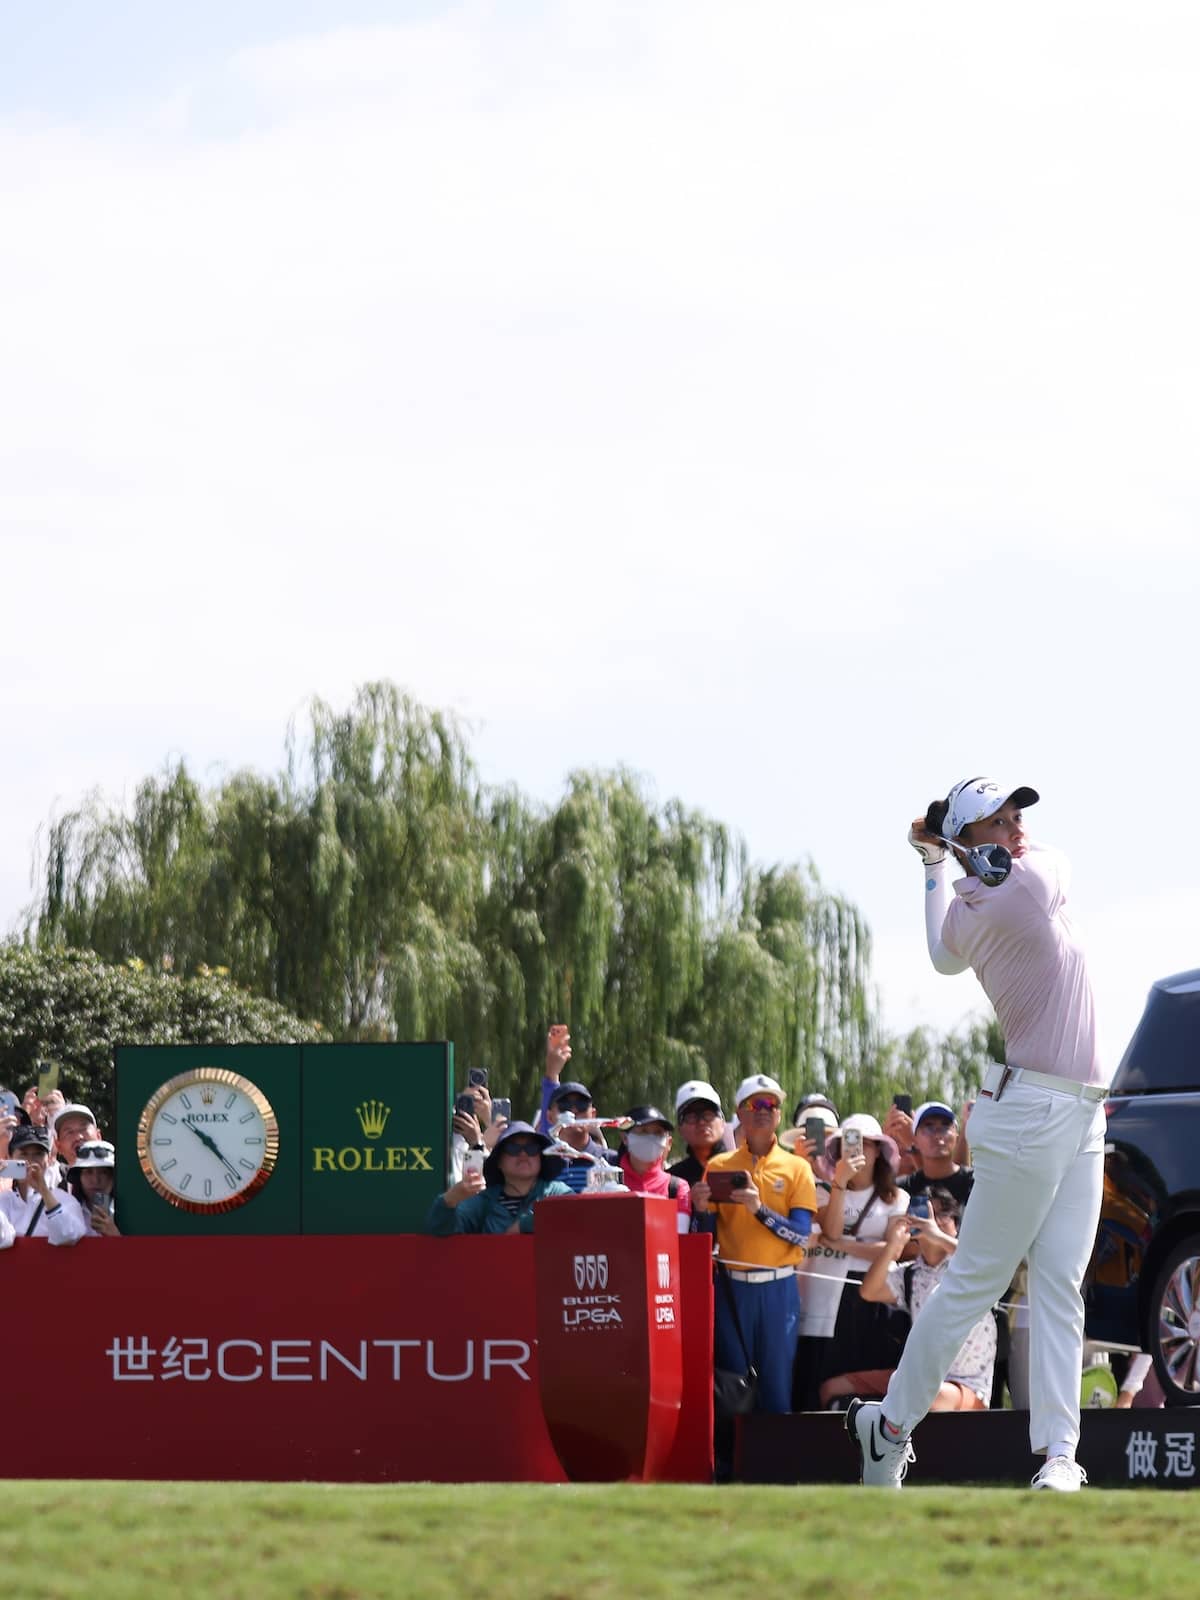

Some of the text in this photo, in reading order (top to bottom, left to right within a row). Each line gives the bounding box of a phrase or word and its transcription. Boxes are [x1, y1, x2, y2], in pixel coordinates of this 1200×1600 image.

[187, 1113, 229, 1123] ROLEX
[312, 1147, 434, 1172] ROLEX
[562, 1295, 622, 1306] BUICK
[562, 1307, 623, 1326] LPGA
[655, 1307, 675, 1323] LPGA
[105, 1336, 538, 1382] 世纪CENTUR
